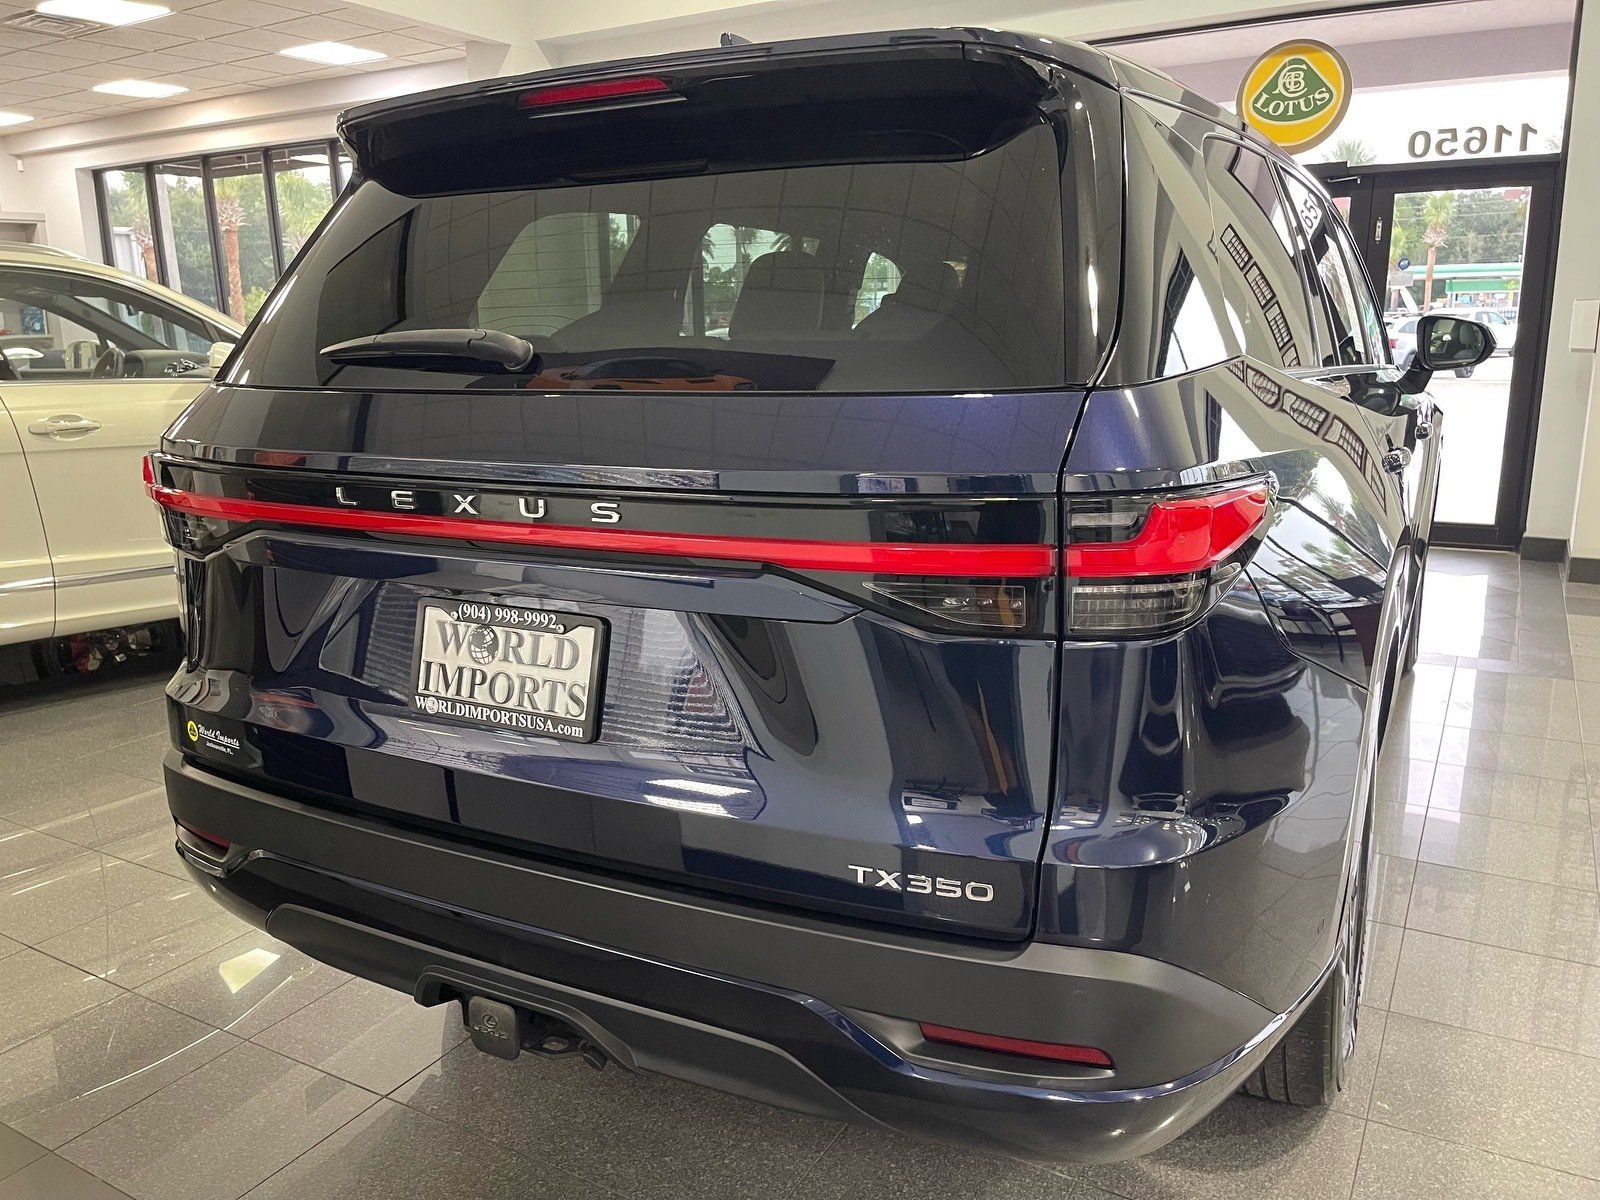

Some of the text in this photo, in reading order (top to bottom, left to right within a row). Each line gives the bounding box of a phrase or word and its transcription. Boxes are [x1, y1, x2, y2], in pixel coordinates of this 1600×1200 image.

[1253, 87, 1330, 116] LOTUS
[335, 486, 622, 524] LEXUS
[458, 603, 557, 629] (904) 998-9992
[436, 619, 581, 671] WORLD
[422, 659, 587, 718] IMPORTS
[415, 695, 584, 738] WORLDIMPORTSUSA.com
